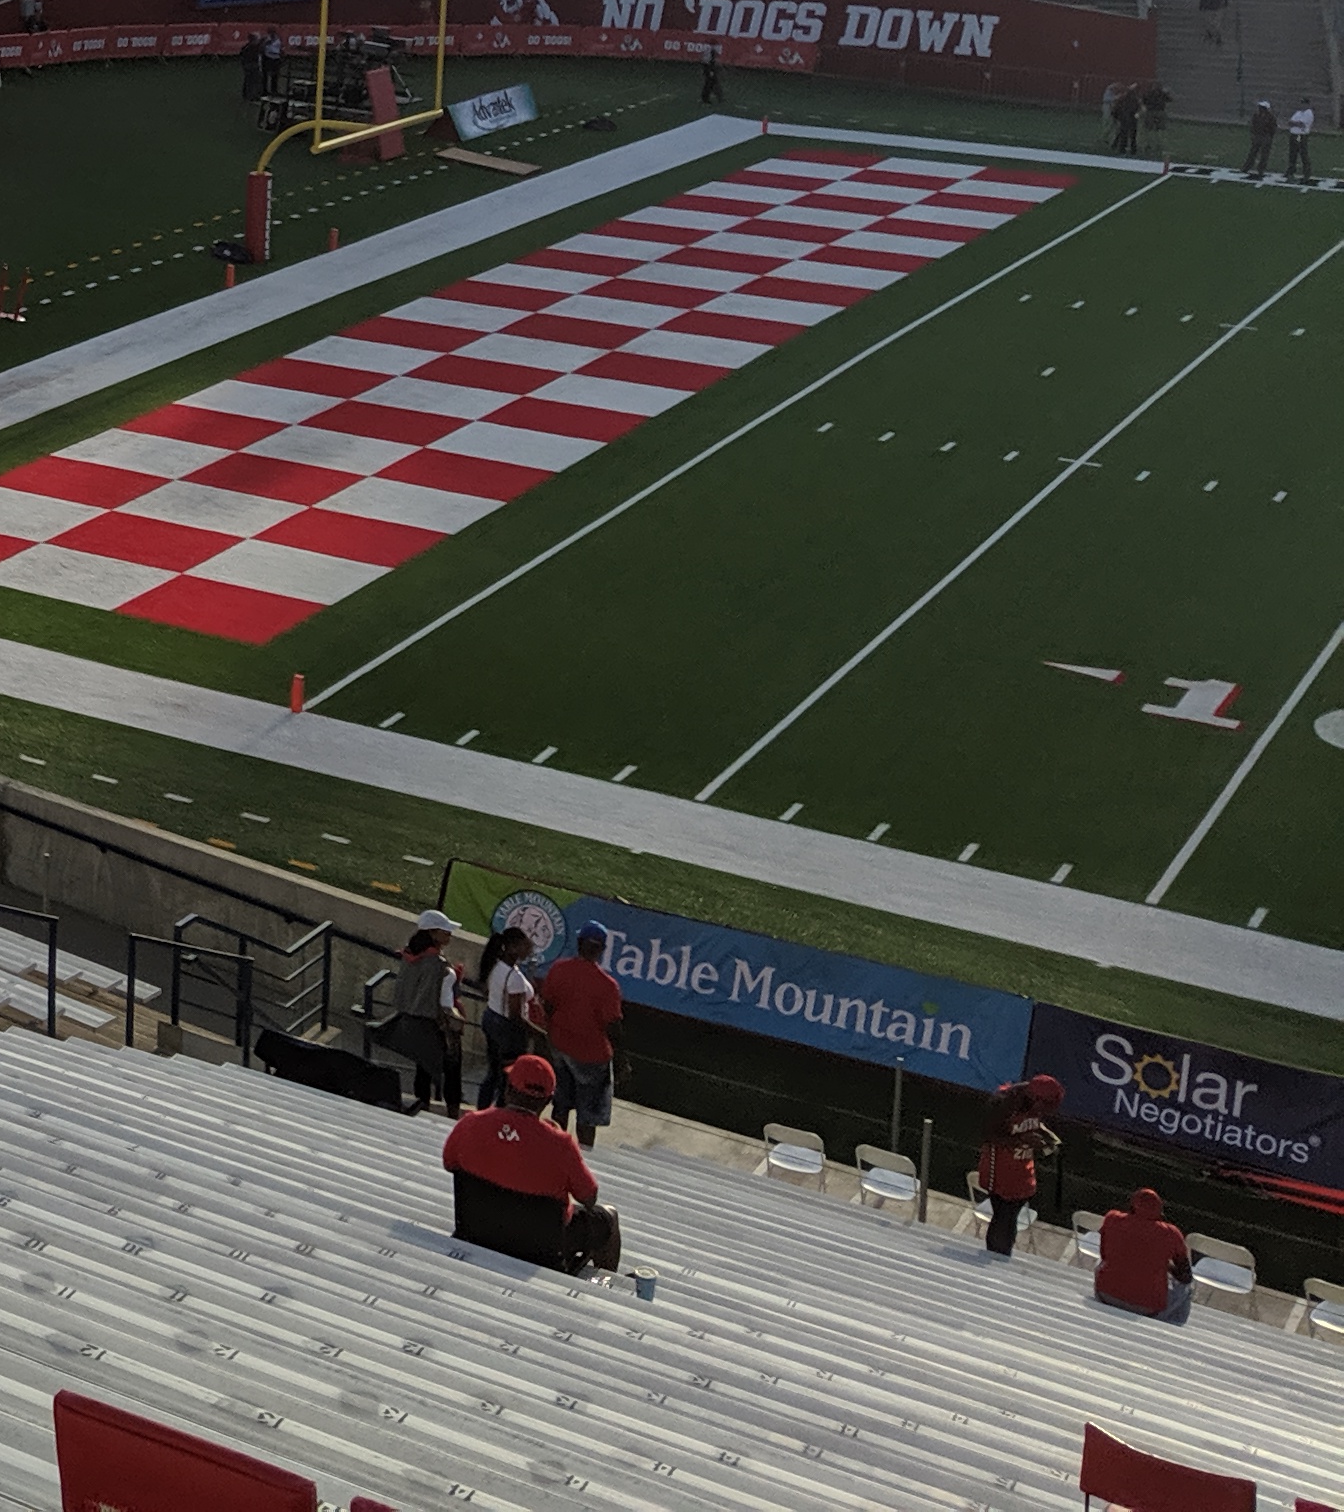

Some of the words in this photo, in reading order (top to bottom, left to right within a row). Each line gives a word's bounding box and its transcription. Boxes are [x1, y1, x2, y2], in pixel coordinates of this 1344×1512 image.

[837, 4, 1000, 58] DOWN
[602, 929, 718, 995] Table
[728, 958, 973, 1060] Mountain
[1090, 1033, 1258, 1118] Solar
[58, 1285, 77, 1300] 11
[80, 1344, 108, 1361] 12
[213, 1343, 239, 1360] 12
[319, 1342, 344, 1358] 12
[402, 1340, 426, 1356] 12
[382, 1407, 409, 1424] 13
[480, 1400, 506, 1416] 13
[257, 1411, 285, 1429] 13
[448, 1483, 476, 1502] 14
